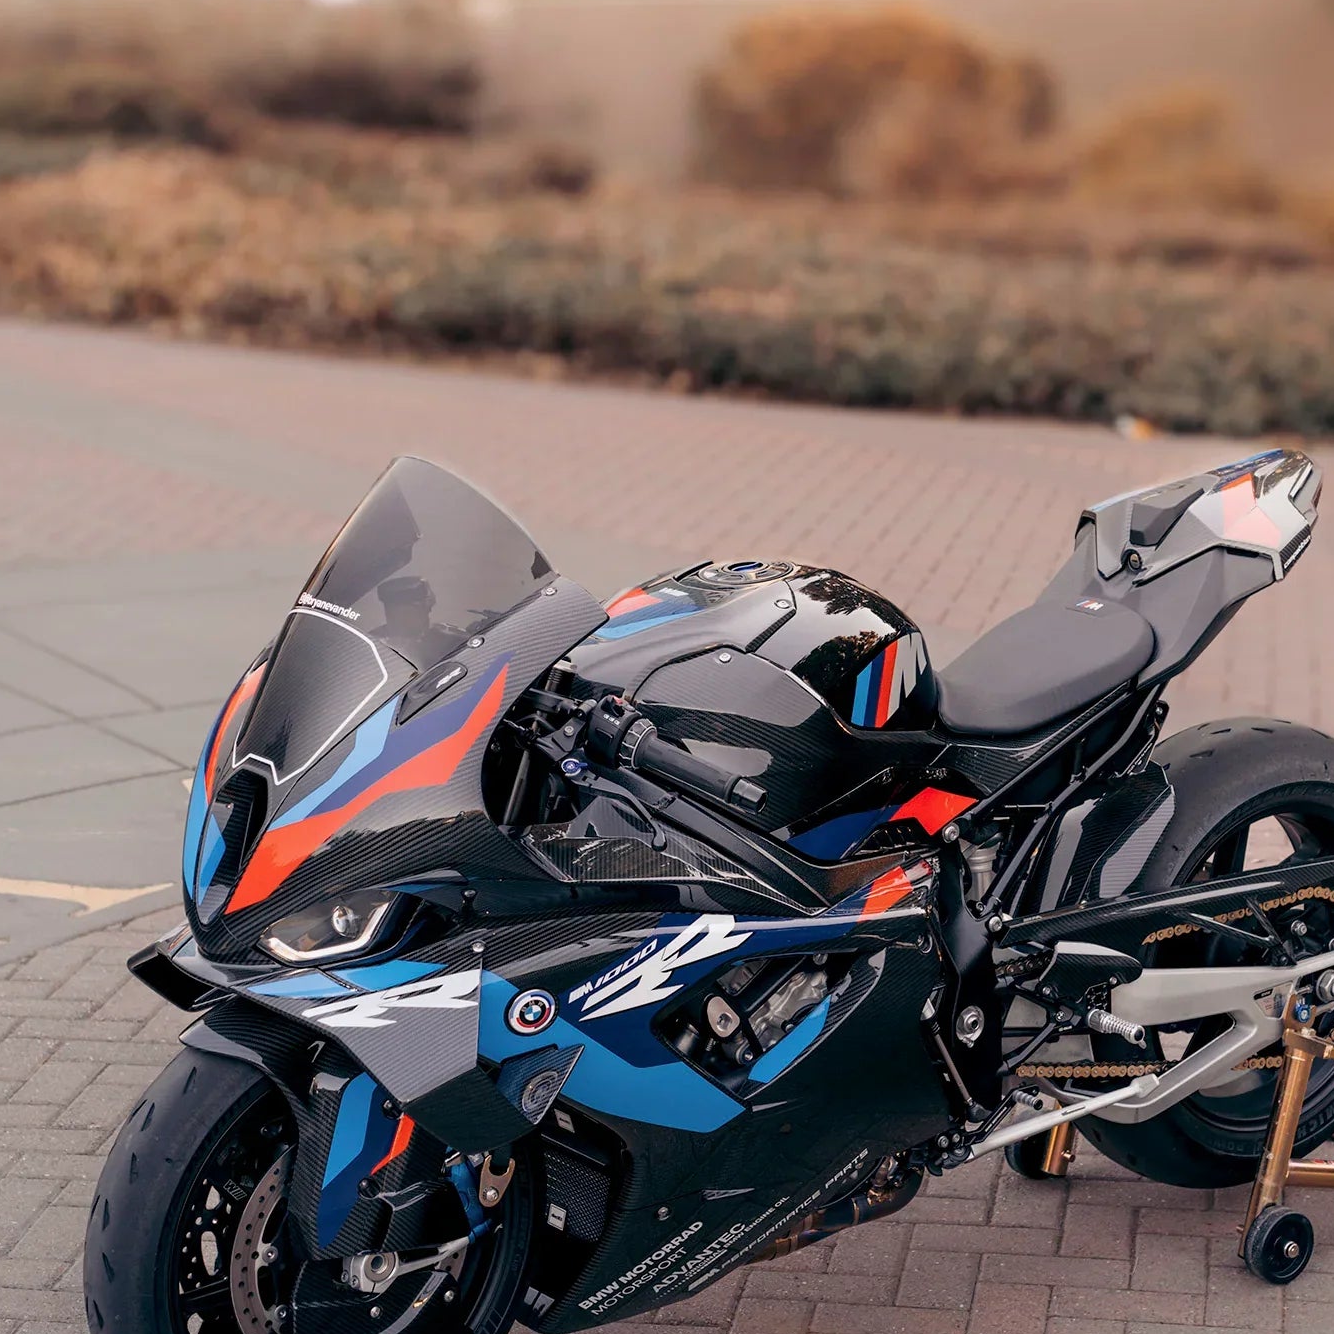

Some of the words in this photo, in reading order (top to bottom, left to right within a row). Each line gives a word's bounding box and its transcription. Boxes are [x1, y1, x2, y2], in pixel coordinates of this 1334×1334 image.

[721, 1189, 821, 1269] PERFORMANCE
[824, 1147, 869, 1189] PARTS
[743, 1205, 776, 1232] ENGINE
[774, 1194, 790, 1210] OIL
[578, 1281, 620, 1311] BMW
[618, 1221, 703, 1284] MOTORRAD
[590, 1246, 688, 1316] MOTORSPORT
[652, 1222, 746, 1293] ADVANTEC
